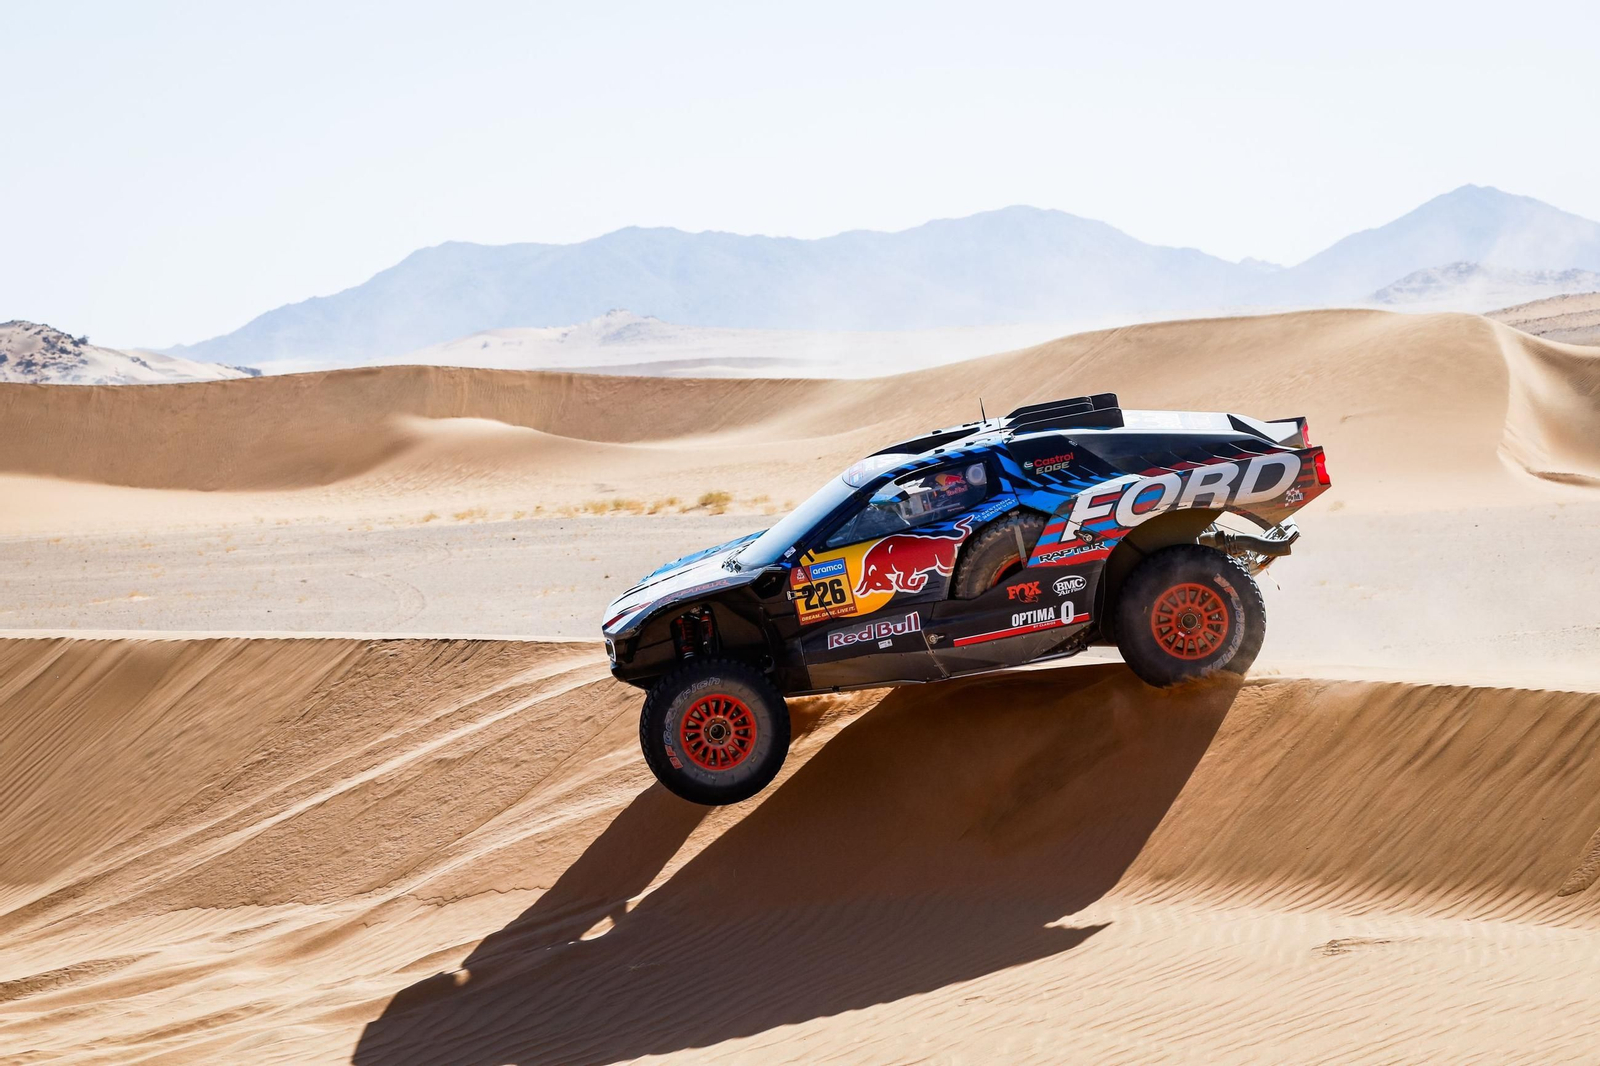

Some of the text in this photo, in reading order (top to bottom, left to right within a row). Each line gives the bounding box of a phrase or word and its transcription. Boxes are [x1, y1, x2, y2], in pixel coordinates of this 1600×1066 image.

[1033, 452, 1074, 468] Castrol
[1035, 461, 1070, 475] EDGE
[1058, 453, 1301, 543] FORD
[1038, 541, 1110, 563] RAPTOR
[812, 563, 843, 575] aramco
[802, 578, 847, 611] 226
[1006, 581, 1042, 600] FOX
[1056, 579, 1084, 591] BMC
[1011, 607, 1055, 627] OPTIMA
[828, 611, 921, 650] Red Bull
